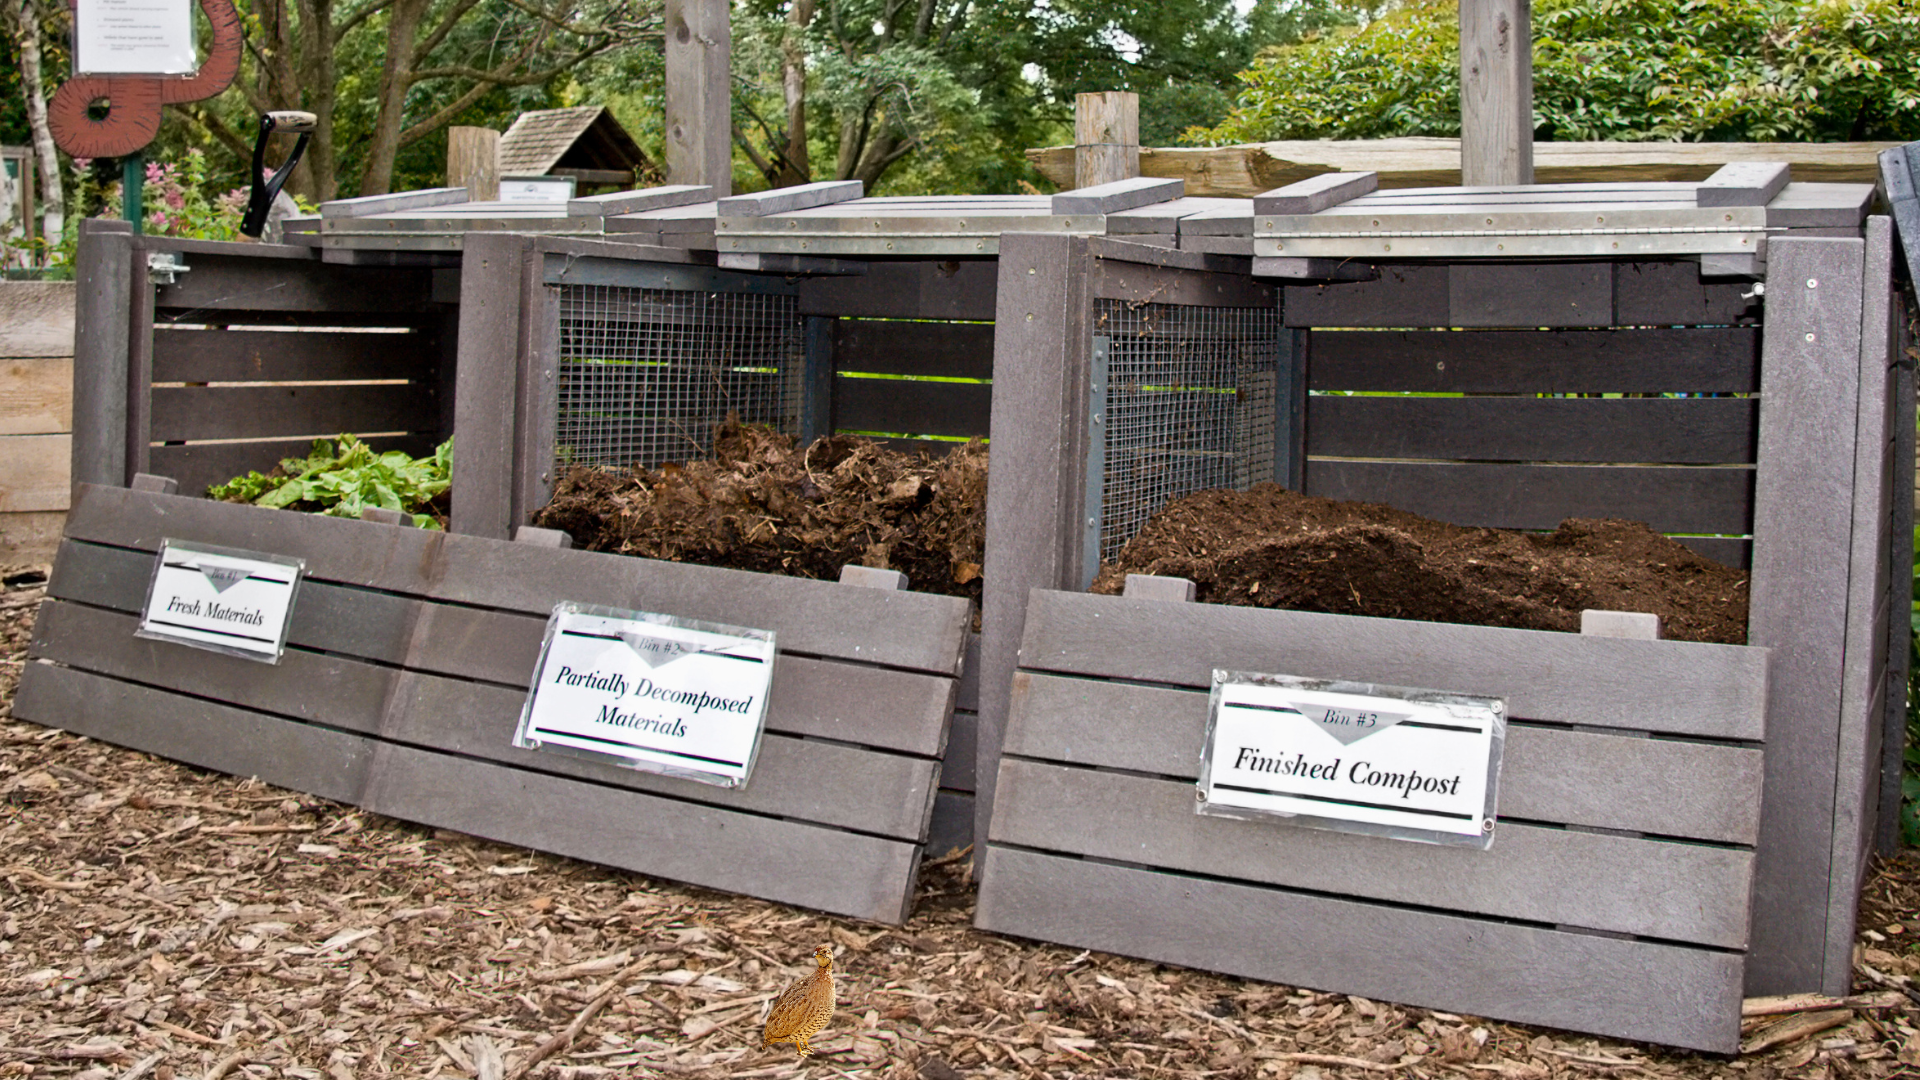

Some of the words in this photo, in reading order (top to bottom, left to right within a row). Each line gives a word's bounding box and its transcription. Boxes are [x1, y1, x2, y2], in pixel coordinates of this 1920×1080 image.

[167, 596, 201, 616] Fresh
[203, 602, 264, 627] Materials
[639, 638, 660, 653] Bin
[664, 641, 681, 656] #2
[555, 666, 630, 700] Partially
[634, 678, 754, 714] Decomposed
[596, 704, 688, 738] Materials
[1323, 709, 1350, 726] Bin
[1356, 713, 1378, 728] #3
[1233, 747, 1341, 781] Finished
[1349, 761, 1461, 799] Compost
